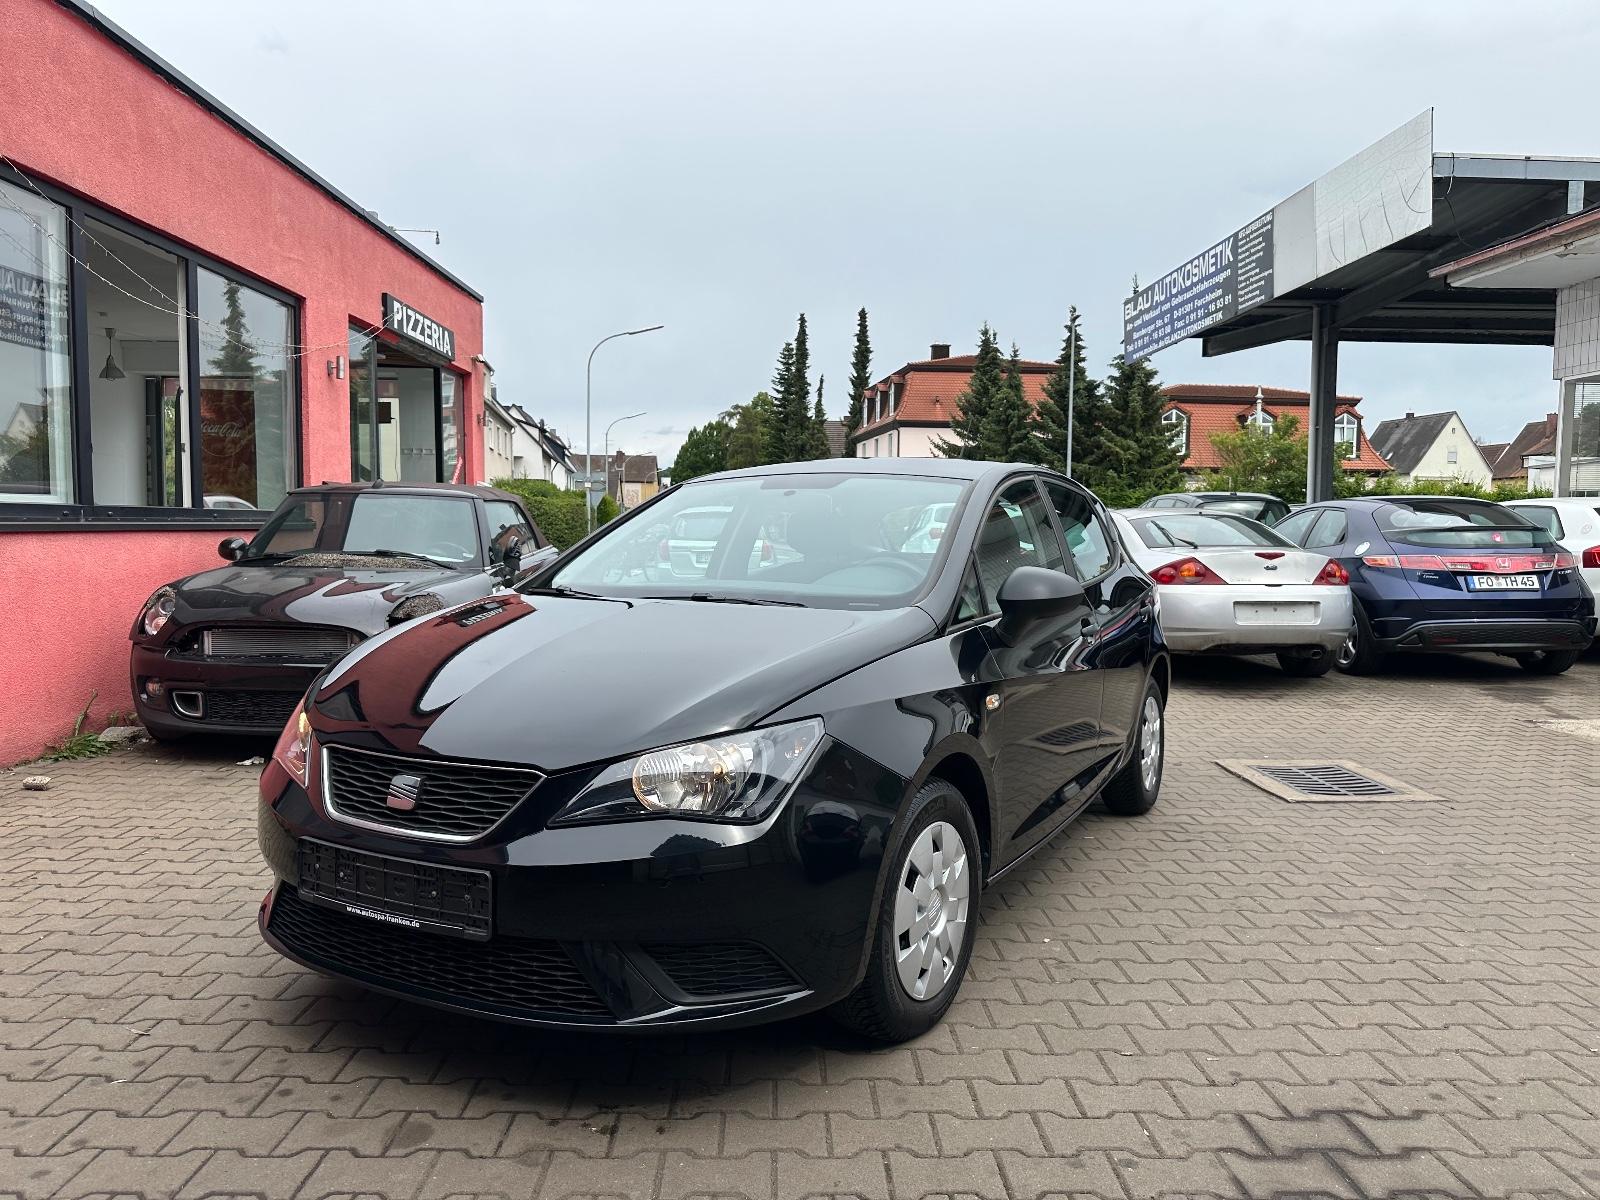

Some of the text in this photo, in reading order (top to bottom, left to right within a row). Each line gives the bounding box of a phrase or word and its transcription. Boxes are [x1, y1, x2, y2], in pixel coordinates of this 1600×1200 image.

[1124, 236, 1233, 321] BLAU AUTOKOSMETIK
[1143, 305, 1160, 322] Verkauf
[1161, 301, 1169, 312] von
[1171, 269, 1230, 307] Gebrauchtfahrzeugen
[393, 300, 452, 356] PIZZERIA
[1133, 324, 1154, 339] Bamberger
[1173, 302, 1192, 319] D-91301
[1194, 288, 1222, 308] Forchheim
[1174, 317, 1184, 330] Fax:
[1190, 311, 1196, 322] 91
[1197, 307, 1203, 318] 91
[1208, 301, 1214, 312] 16
[1216, 297, 1223, 309] 93
[1224, 292, 1231, 304] 81
[1478, 576, 1535, 587] FO TH 45
[346, 906, 420, 928] www.autospa-franken.de
